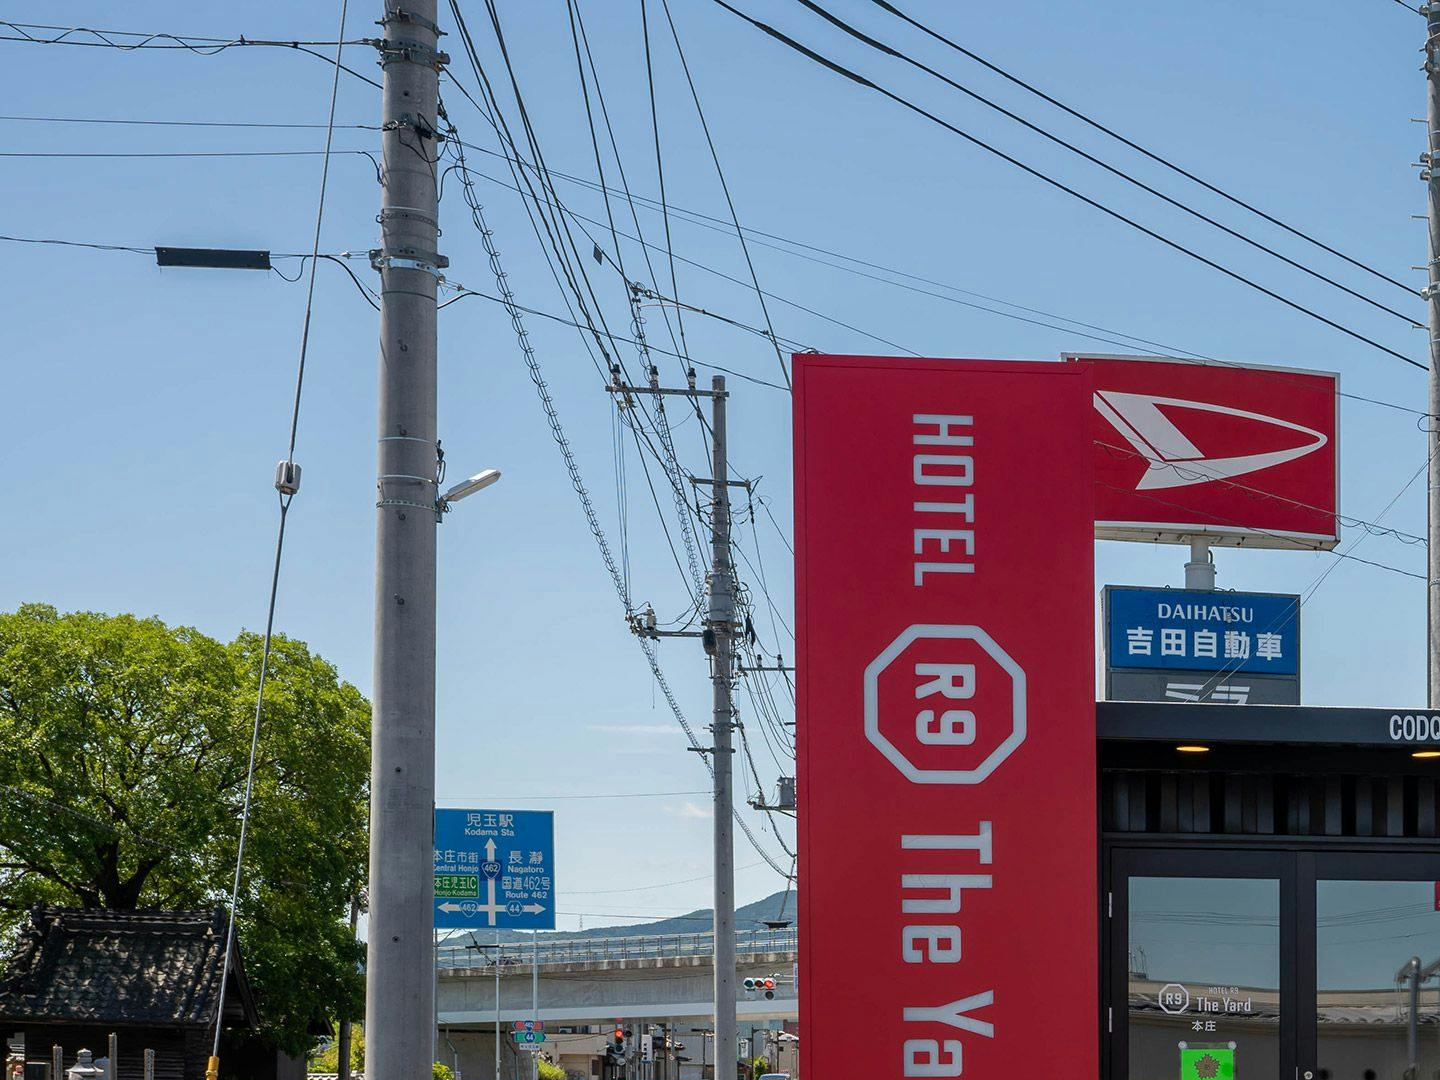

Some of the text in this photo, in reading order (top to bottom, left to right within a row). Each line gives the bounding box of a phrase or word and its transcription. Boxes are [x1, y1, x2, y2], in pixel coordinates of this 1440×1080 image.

[912, 413, 975, 587] HOTEL
[1157, 603, 1254, 623] DAIHATSU
[1126, 626, 1283, 661] 吉田自動車
[915, 662, 976, 746] R9
[467, 813, 514, 827] 児玉駅
[465, 828, 498, 836] Kodama
[433, 850, 478, 863] 本庄市街
[458, 865, 479, 873] Honjo
[508, 866, 544, 874] Nagatoro
[502, 876, 551, 891] 国道462号
[901, 820, 993, 964] The
[509, 905, 520, 913] 44
[1166, 993, 1182, 1005] R9
[1197, 997, 1251, 1012] The Yard
[1192, 1020, 1216, 1032] 本庄
